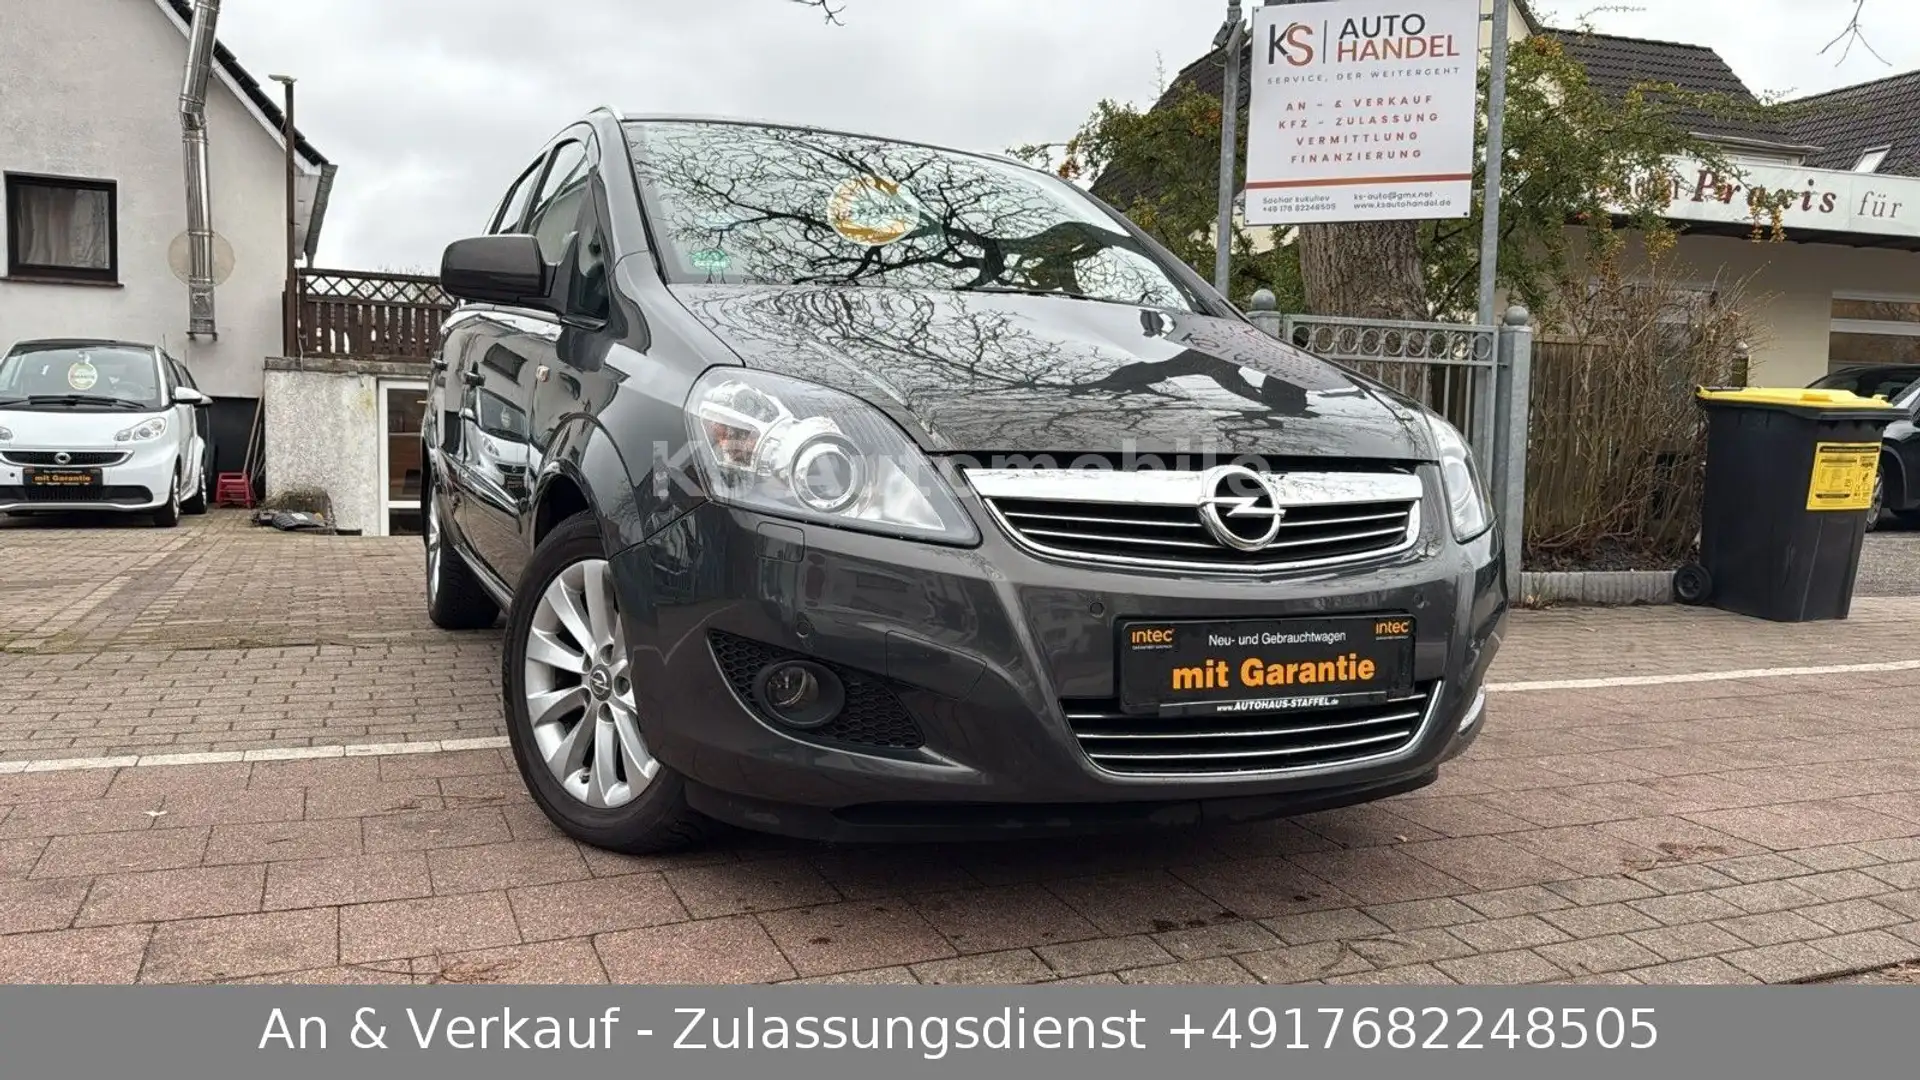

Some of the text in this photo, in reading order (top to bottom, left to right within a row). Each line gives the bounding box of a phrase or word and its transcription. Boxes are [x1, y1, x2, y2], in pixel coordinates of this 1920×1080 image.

[1339, 13, 1426, 40] AUTO
[1268, 22, 1314, 67] KS
[1337, 35, 1460, 63] HANDEL
[1336, 71, 1363, 81] DER
[1370, 67, 1461, 78] WEITERGEHT
[1286, 102, 1306, 111] AN
[1334, 99, 1342, 109] &
[1353, 94, 1433, 108] VERKAUF
[1278, 119, 1308, 130] KFZ
[1335, 112, 1439, 126] ZULASSUNG
[1296, 131, 1418, 146] VERMITTLUNG
[1290, 149, 1422, 164] FINANZIERUNG
[1353, 198, 1452, 210] www.ksautohandel.de
[1857, 190, 1903, 219] für
[1208, 631, 1346, 646] Neu- und Gebrauchtwagen
[1172, 652, 1376, 689] mit Garantie
[1216, 697, 1339, 711] www.AUTOHAUS-STAFFEL.de
